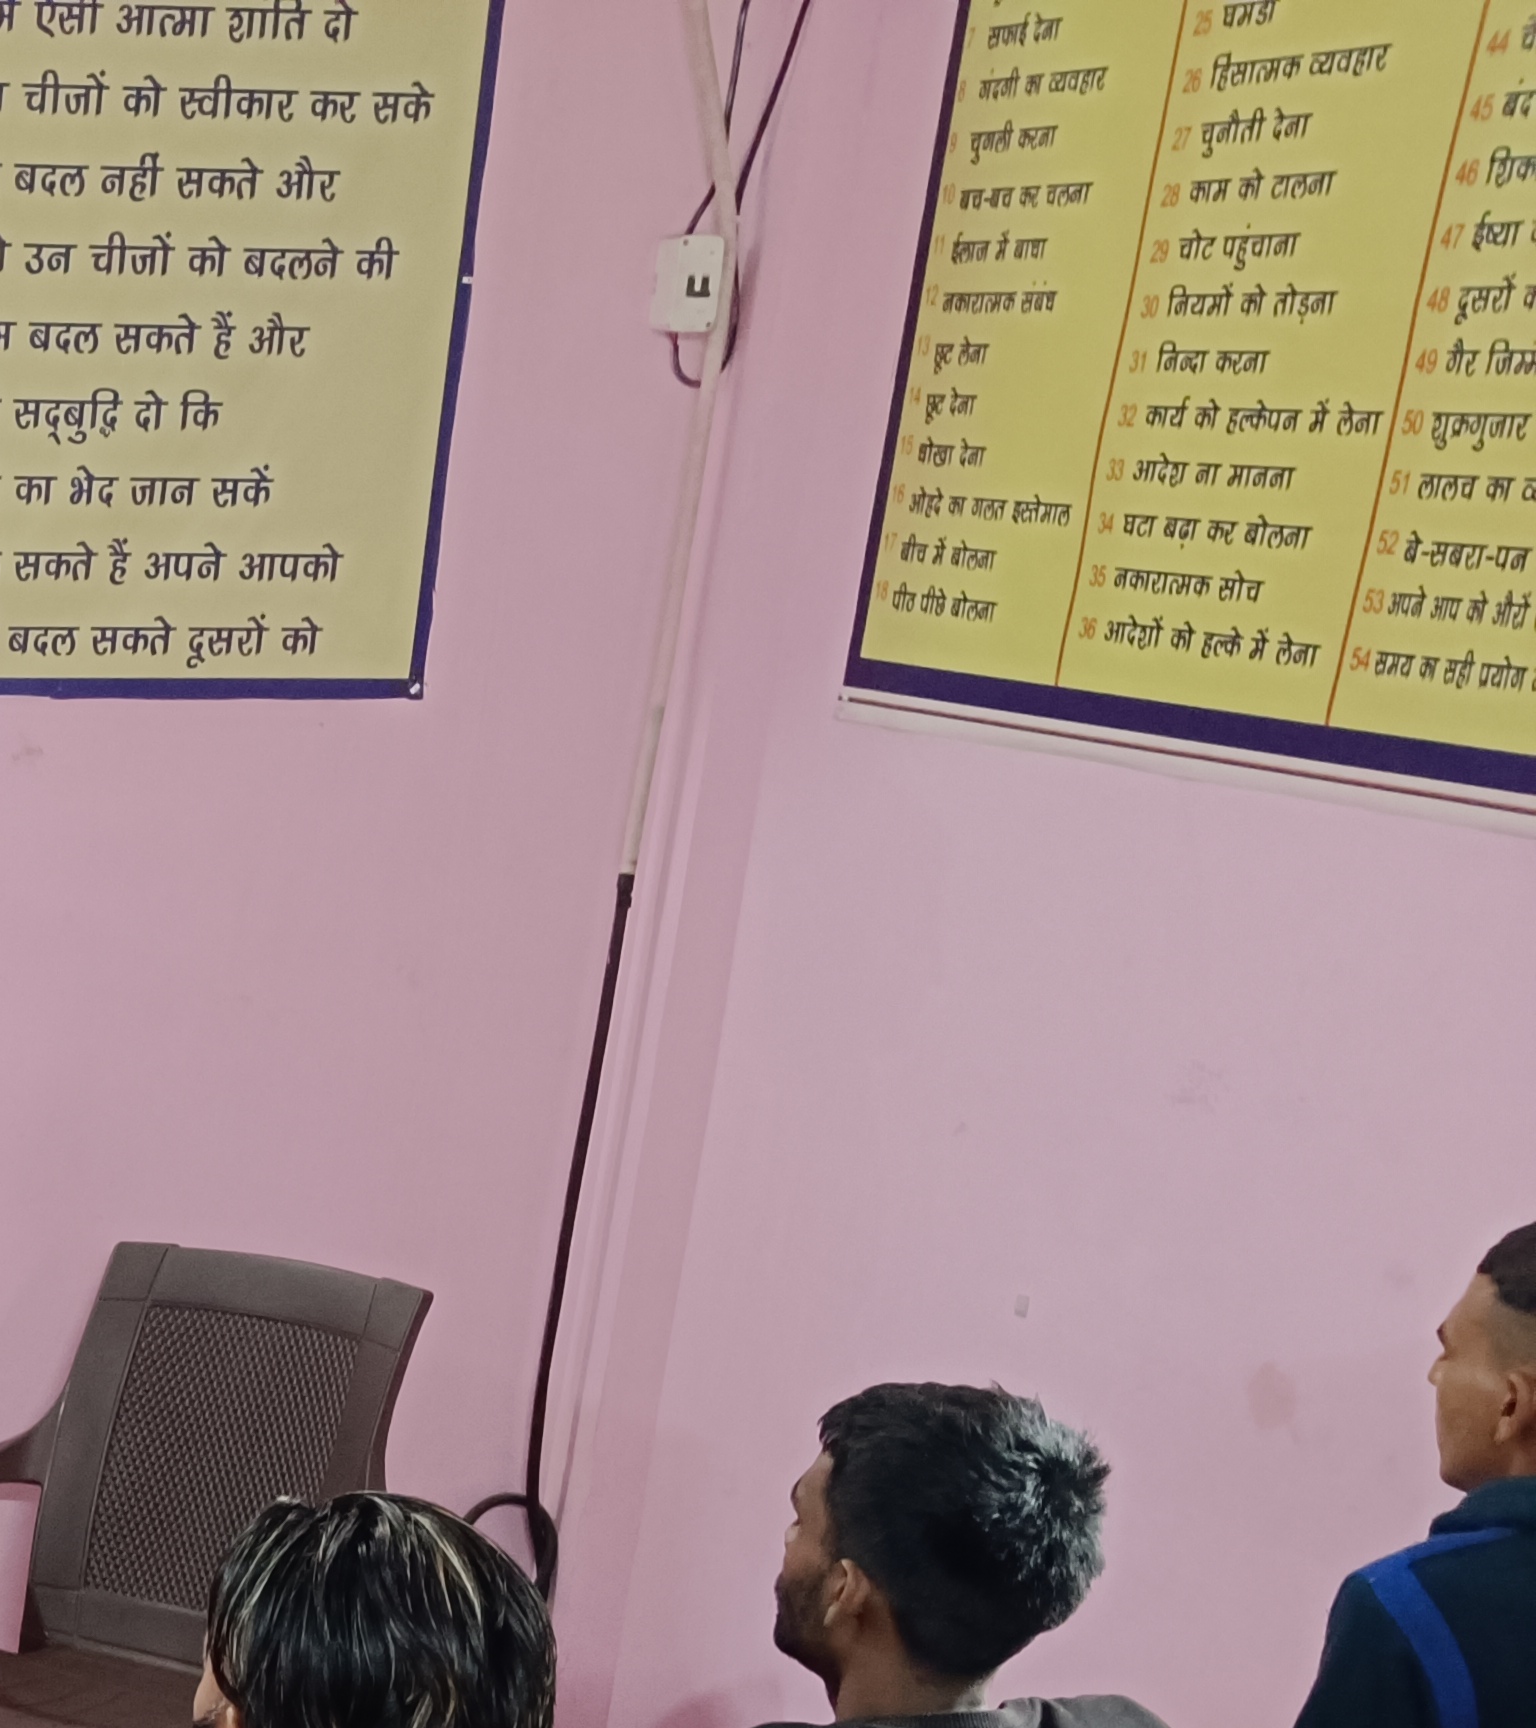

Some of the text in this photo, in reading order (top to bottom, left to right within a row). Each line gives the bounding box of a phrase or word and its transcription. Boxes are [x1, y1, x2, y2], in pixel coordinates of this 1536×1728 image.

[116, 4, 216, 37] आत्मा
[1183, 69, 1201, 93] 26
[1309, 43, 1392, 77] व्यवहार
[22, 69, 110, 116] चीजों
[122, 74, 167, 117] को
[179, 74, 299, 122] स्वीकार
[310, 91, 361, 124] कर
[372, 81, 435, 124] सके
[1172, 107, 1313, 159] 27 चुनौती देना
[14, 163, 89, 197] बदल
[100, 152, 164, 202] नहीं
[176, 157, 264, 200] सकते
[276, 155, 341, 202] और
[1161, 167, 1338, 207] 28 काम को टालना
[23, 243, 78, 274] उन
[88, 231, 175, 276] चीजों
[188, 235, 232, 277] को
[243, 237, 344, 280] बदलने
[355, 237, 400, 280] की
[1427, 273, 1516, 325] 48 दूसरों
[28, 322, 103, 354] बदल
[114, 313, 202, 355] सकते
[211, 310, 237, 360] हैं
[249, 312, 311, 358] और
[134, 389, 169, 432] दो
[180, 389, 223, 431] कि
[1118, 396, 1385, 436] 32 कार्य को हल्केपन में लेना
[1402, 410, 1533, 452] 50 शुक्रगुजार
[14, 476, 58, 505] का
[70, 465, 119, 508] भेद
[130, 477, 201, 507] जान
[211, 464, 274, 508] सकें
[1390, 470, 1516, 502] 51 लालच का
[13, 541, 98, 581] सकते
[107, 538, 132, 585] हैं
[144, 542, 227, 582] अपने
[239, 543, 344, 582] आपको
[8, 626, 80, 656] बदल
[91, 615, 177, 656] सकते
[186, 613, 270, 668] दूसरों
[281, 616, 323, 655] को
[1079, 614, 1322, 667] 36 आदेशों को हल्के में लेना
